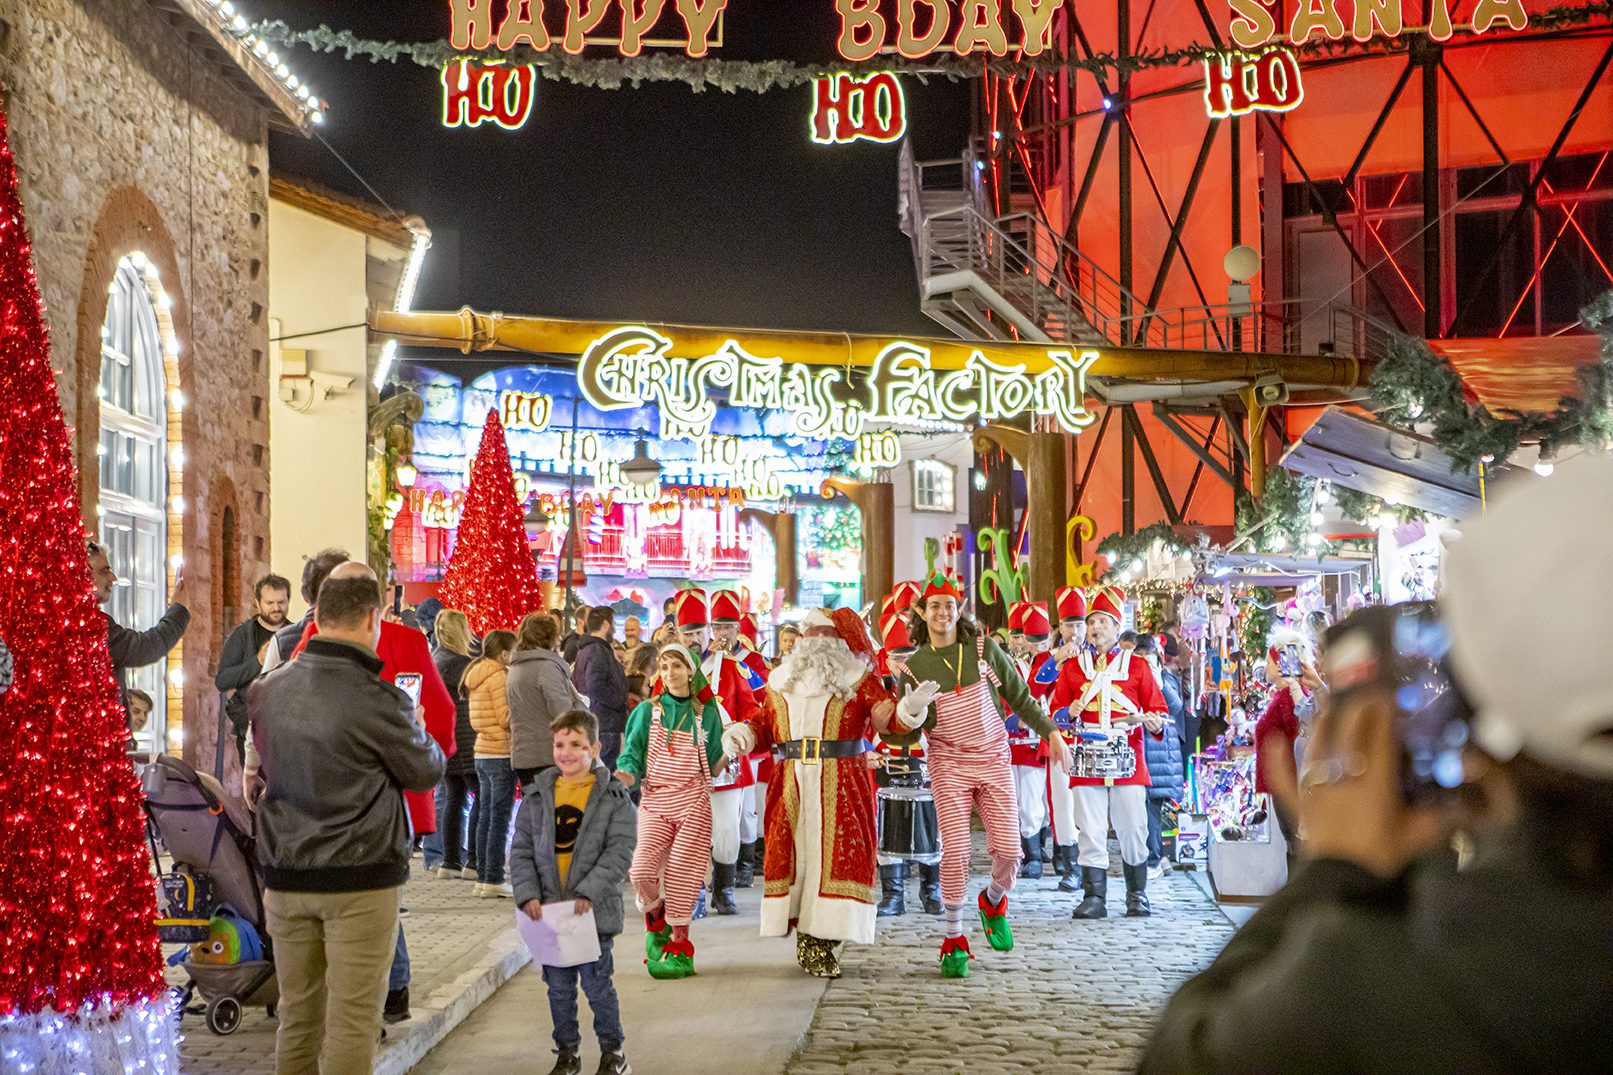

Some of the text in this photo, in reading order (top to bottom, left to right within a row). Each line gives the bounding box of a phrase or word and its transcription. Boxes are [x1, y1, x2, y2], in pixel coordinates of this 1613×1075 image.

[450, 0, 728, 57] HAPPY
[836, 0, 1063, 61] BDAY
[440, 55, 537, 130] HO
[809, 70, 907, 144] HO
[1203, 46, 1304, 118] HO
[500, 390, 552, 432] HO
[867, 340, 1101, 434] FACTORY
[854, 430, 901, 468] HO
[410, 488, 467, 514] HAP
